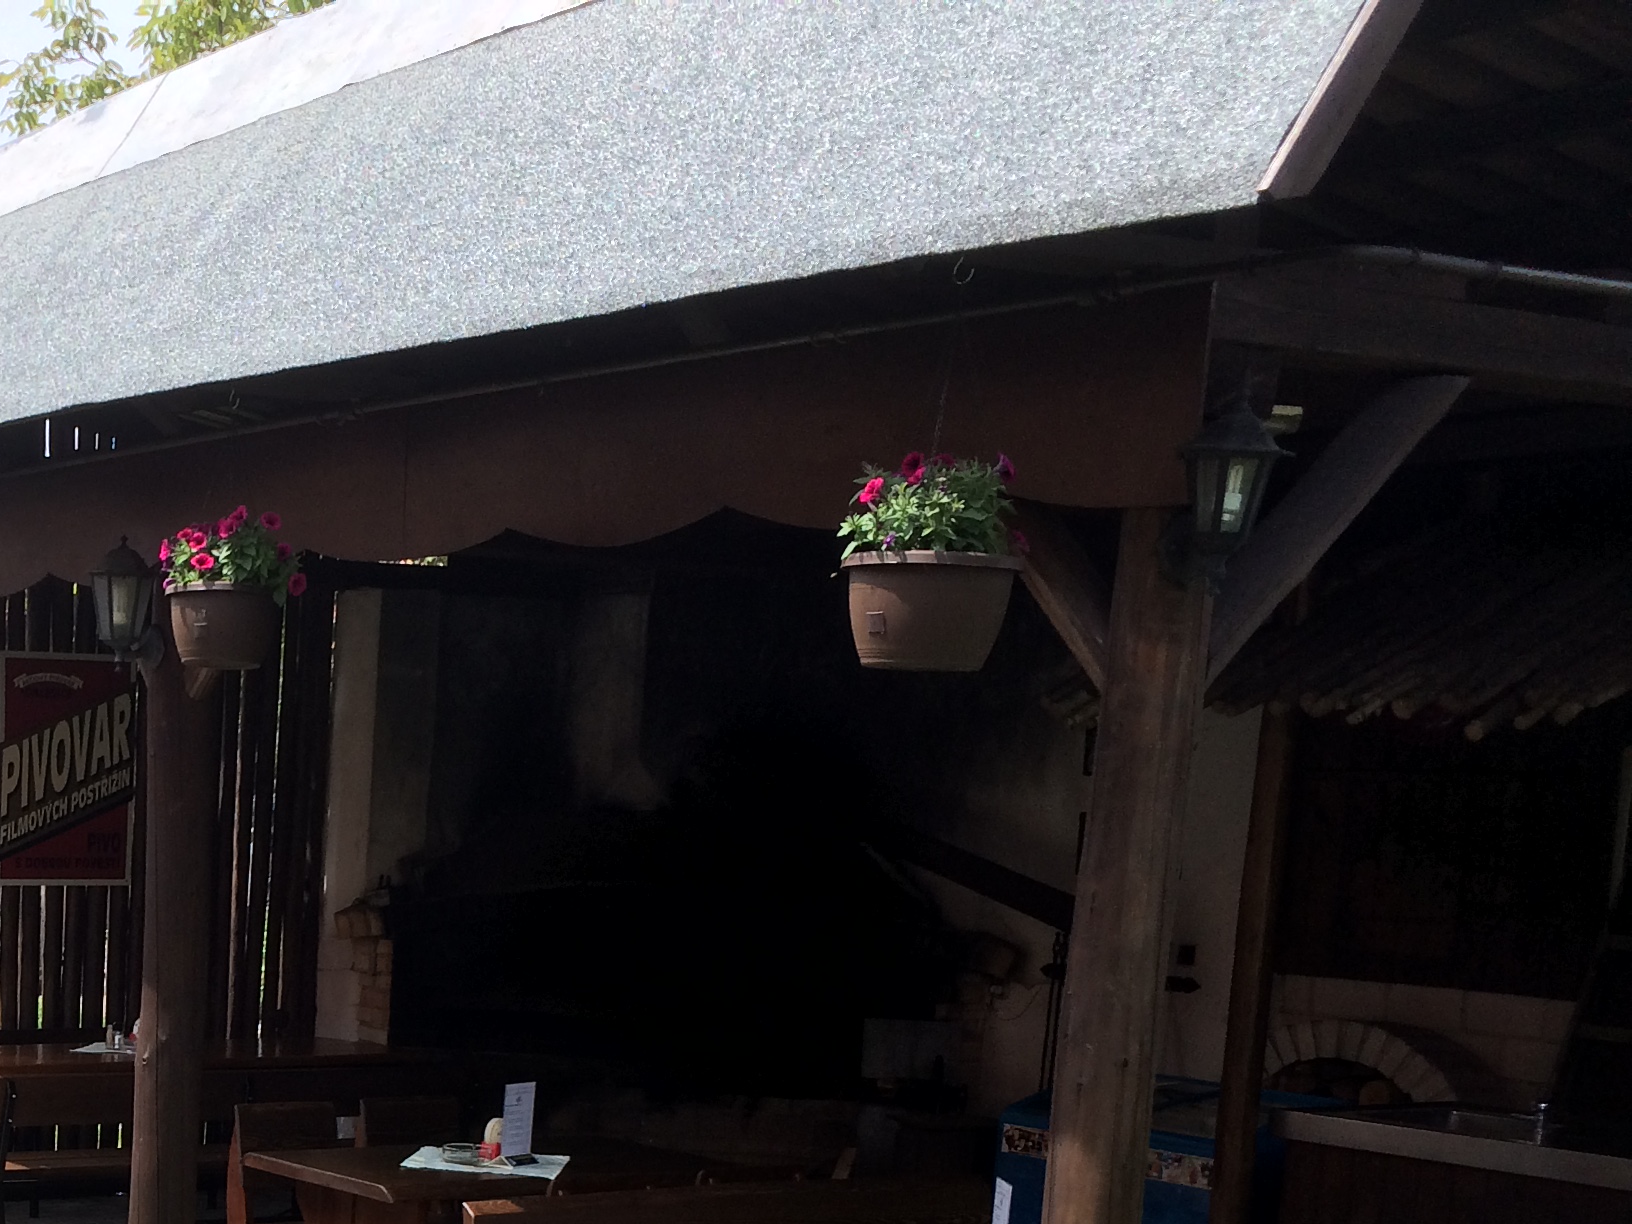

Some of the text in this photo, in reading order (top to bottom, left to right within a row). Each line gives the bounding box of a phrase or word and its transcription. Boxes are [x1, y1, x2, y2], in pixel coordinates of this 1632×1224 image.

[0, 693, 131, 817] PIVOVAR
[0, 796, 68, 845] FILMOVÝCH
[87, 832, 121, 853] PIVO
